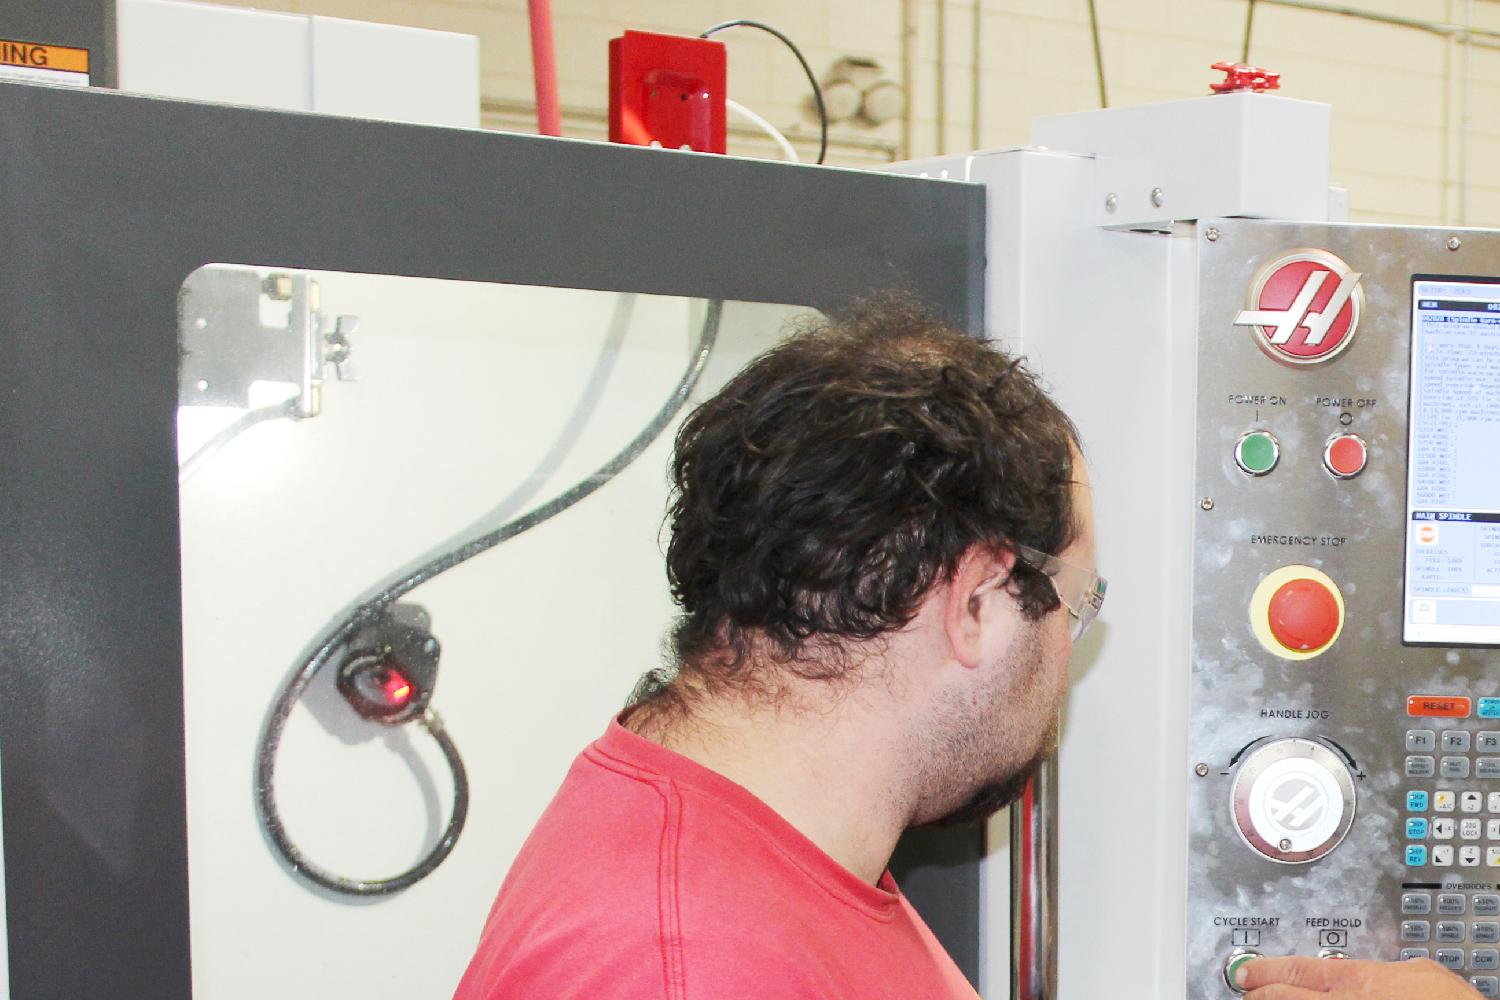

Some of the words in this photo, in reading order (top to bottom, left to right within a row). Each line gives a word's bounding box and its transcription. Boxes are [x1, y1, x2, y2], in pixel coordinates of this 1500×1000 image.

[0, 42, 48, 67] ING
[1228, 395, 1265, 405] POWER
[1269, 396, 1287, 406] ON
[1316, 397, 1352, 408] POWER
[1357, 398, 1377, 408] OFF
[1415, 512, 1436, 520] MAIN
[1438, 512, 1472, 521] SPINDLE
[1250, 535, 1317, 547] EMERGENCY
[1319, 536, 1347, 547] STOP
[1423, 702, 1456, 711] RESET
[1260, 709, 1302, 719] HANDLE
[1304, 709, 1330, 720] JOG
[1415, 736, 1426, 744] F1
[1450, 737, 1462, 746] F2
[1485, 738, 1497, 746] F3
[1214, 917, 1245, 928] CYCLE
[1247, 917, 1280, 927] START
[1305, 917, 1330, 928] FEED
[1332, 918, 1362, 928] HOLD
